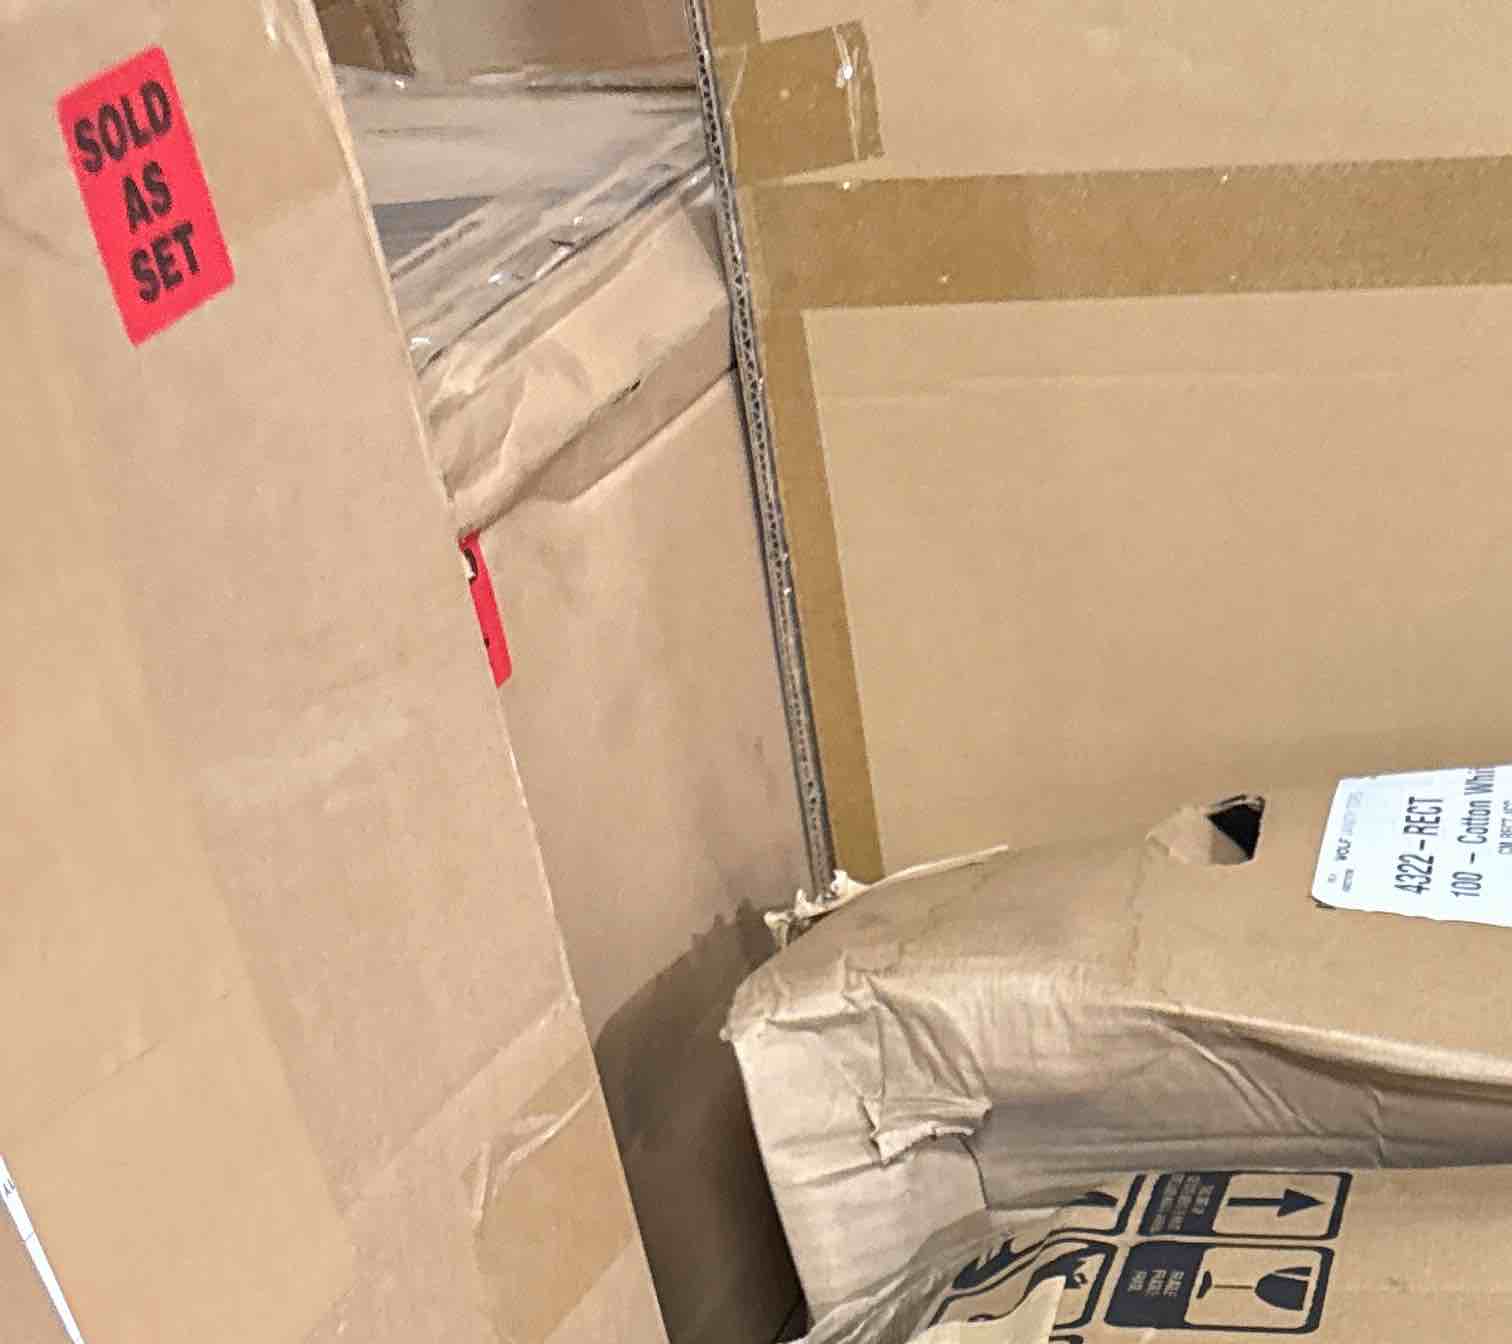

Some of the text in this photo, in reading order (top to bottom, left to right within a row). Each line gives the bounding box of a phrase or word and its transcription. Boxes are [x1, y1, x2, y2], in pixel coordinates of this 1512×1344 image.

[74, 80, 172, 174] SOLD
[123, 160, 172, 235] AS
[131, 221, 200, 303] SET
[1403, 796, 1443, 835] RECT
[1457, 800, 1491, 844] Cotton
[1394, 854, 1434, 894] 4322
[1450, 871, 1482, 897] 100
